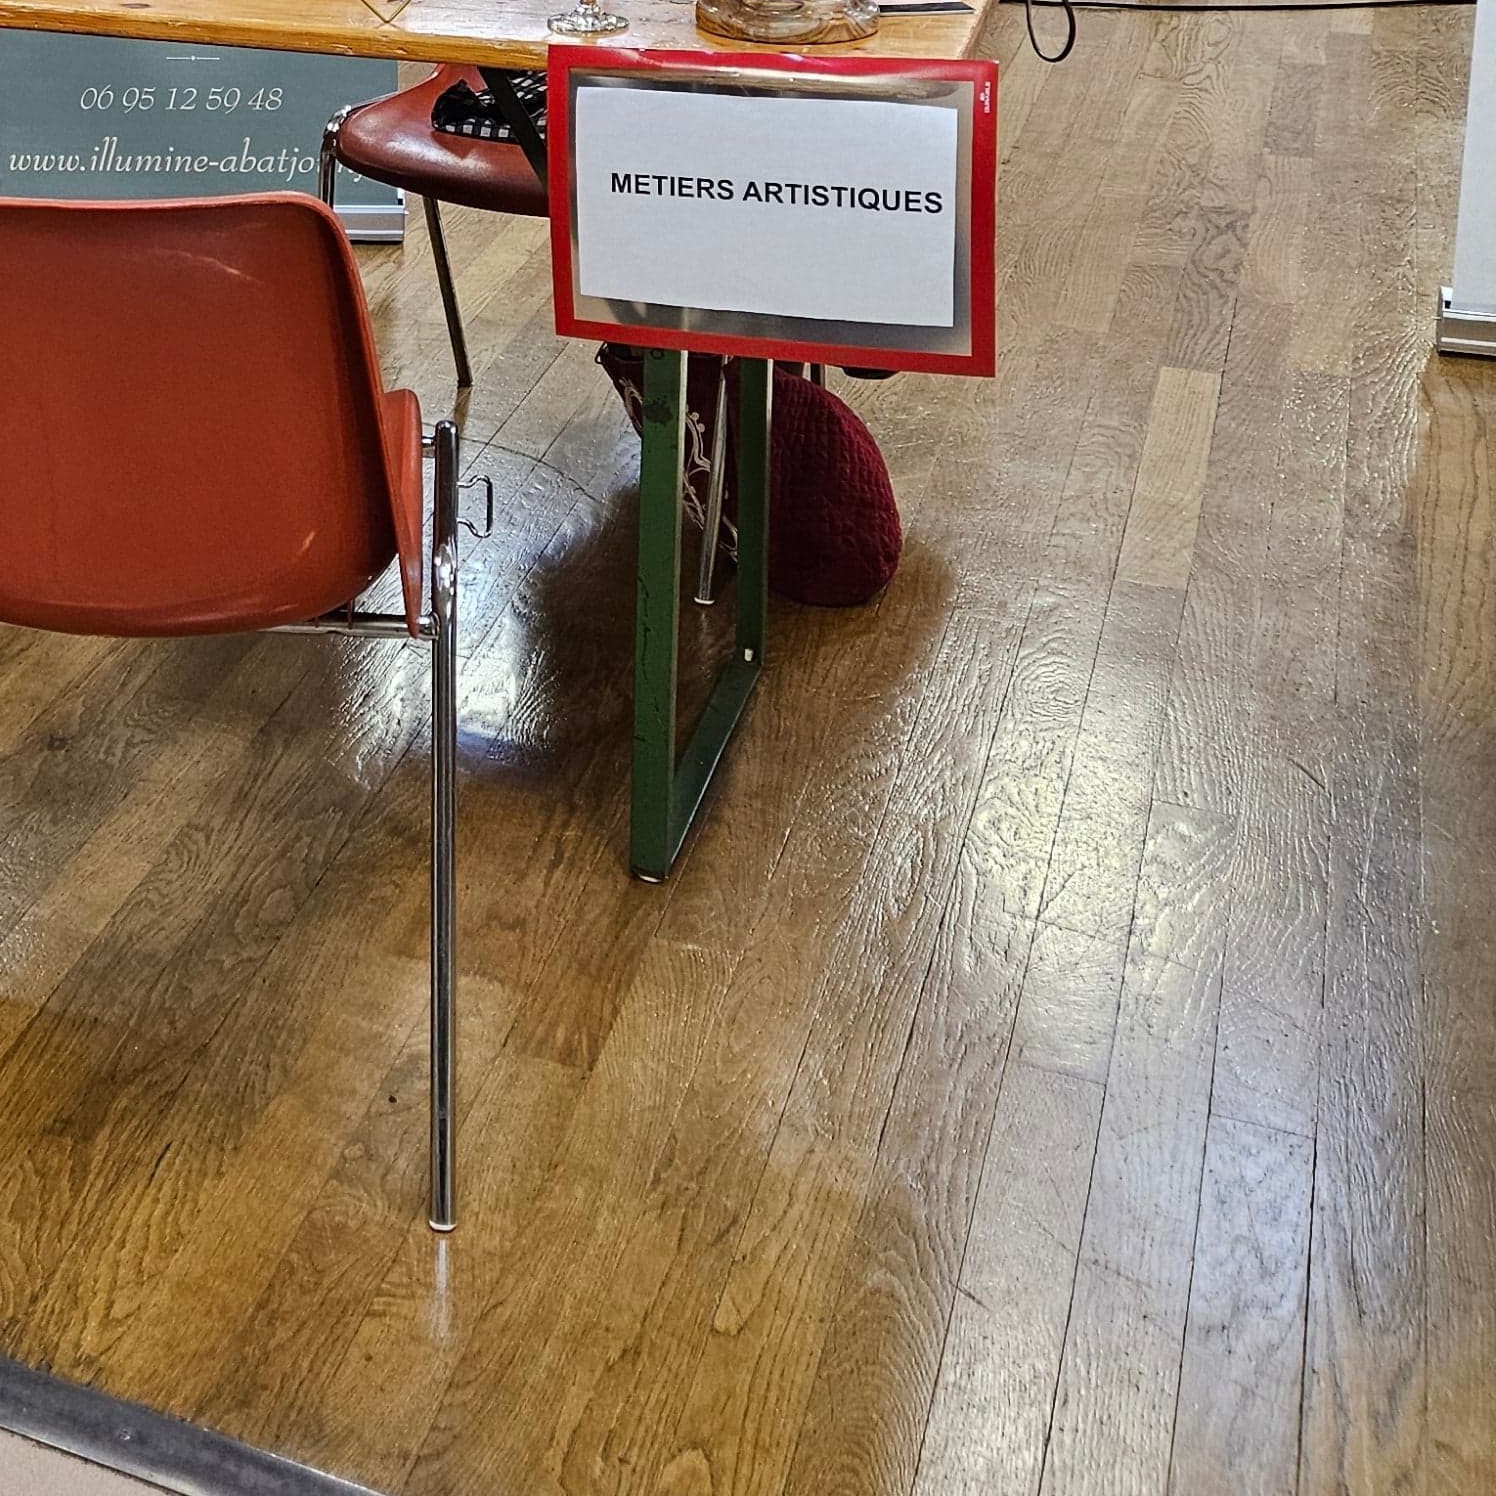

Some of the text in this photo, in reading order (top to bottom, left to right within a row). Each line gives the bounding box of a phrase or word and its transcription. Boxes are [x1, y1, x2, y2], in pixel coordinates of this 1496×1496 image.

[80, 83, 284, 114] 06 95 12 59 48
[611, 172, 943, 214] METIERS ARTISTIQUES
